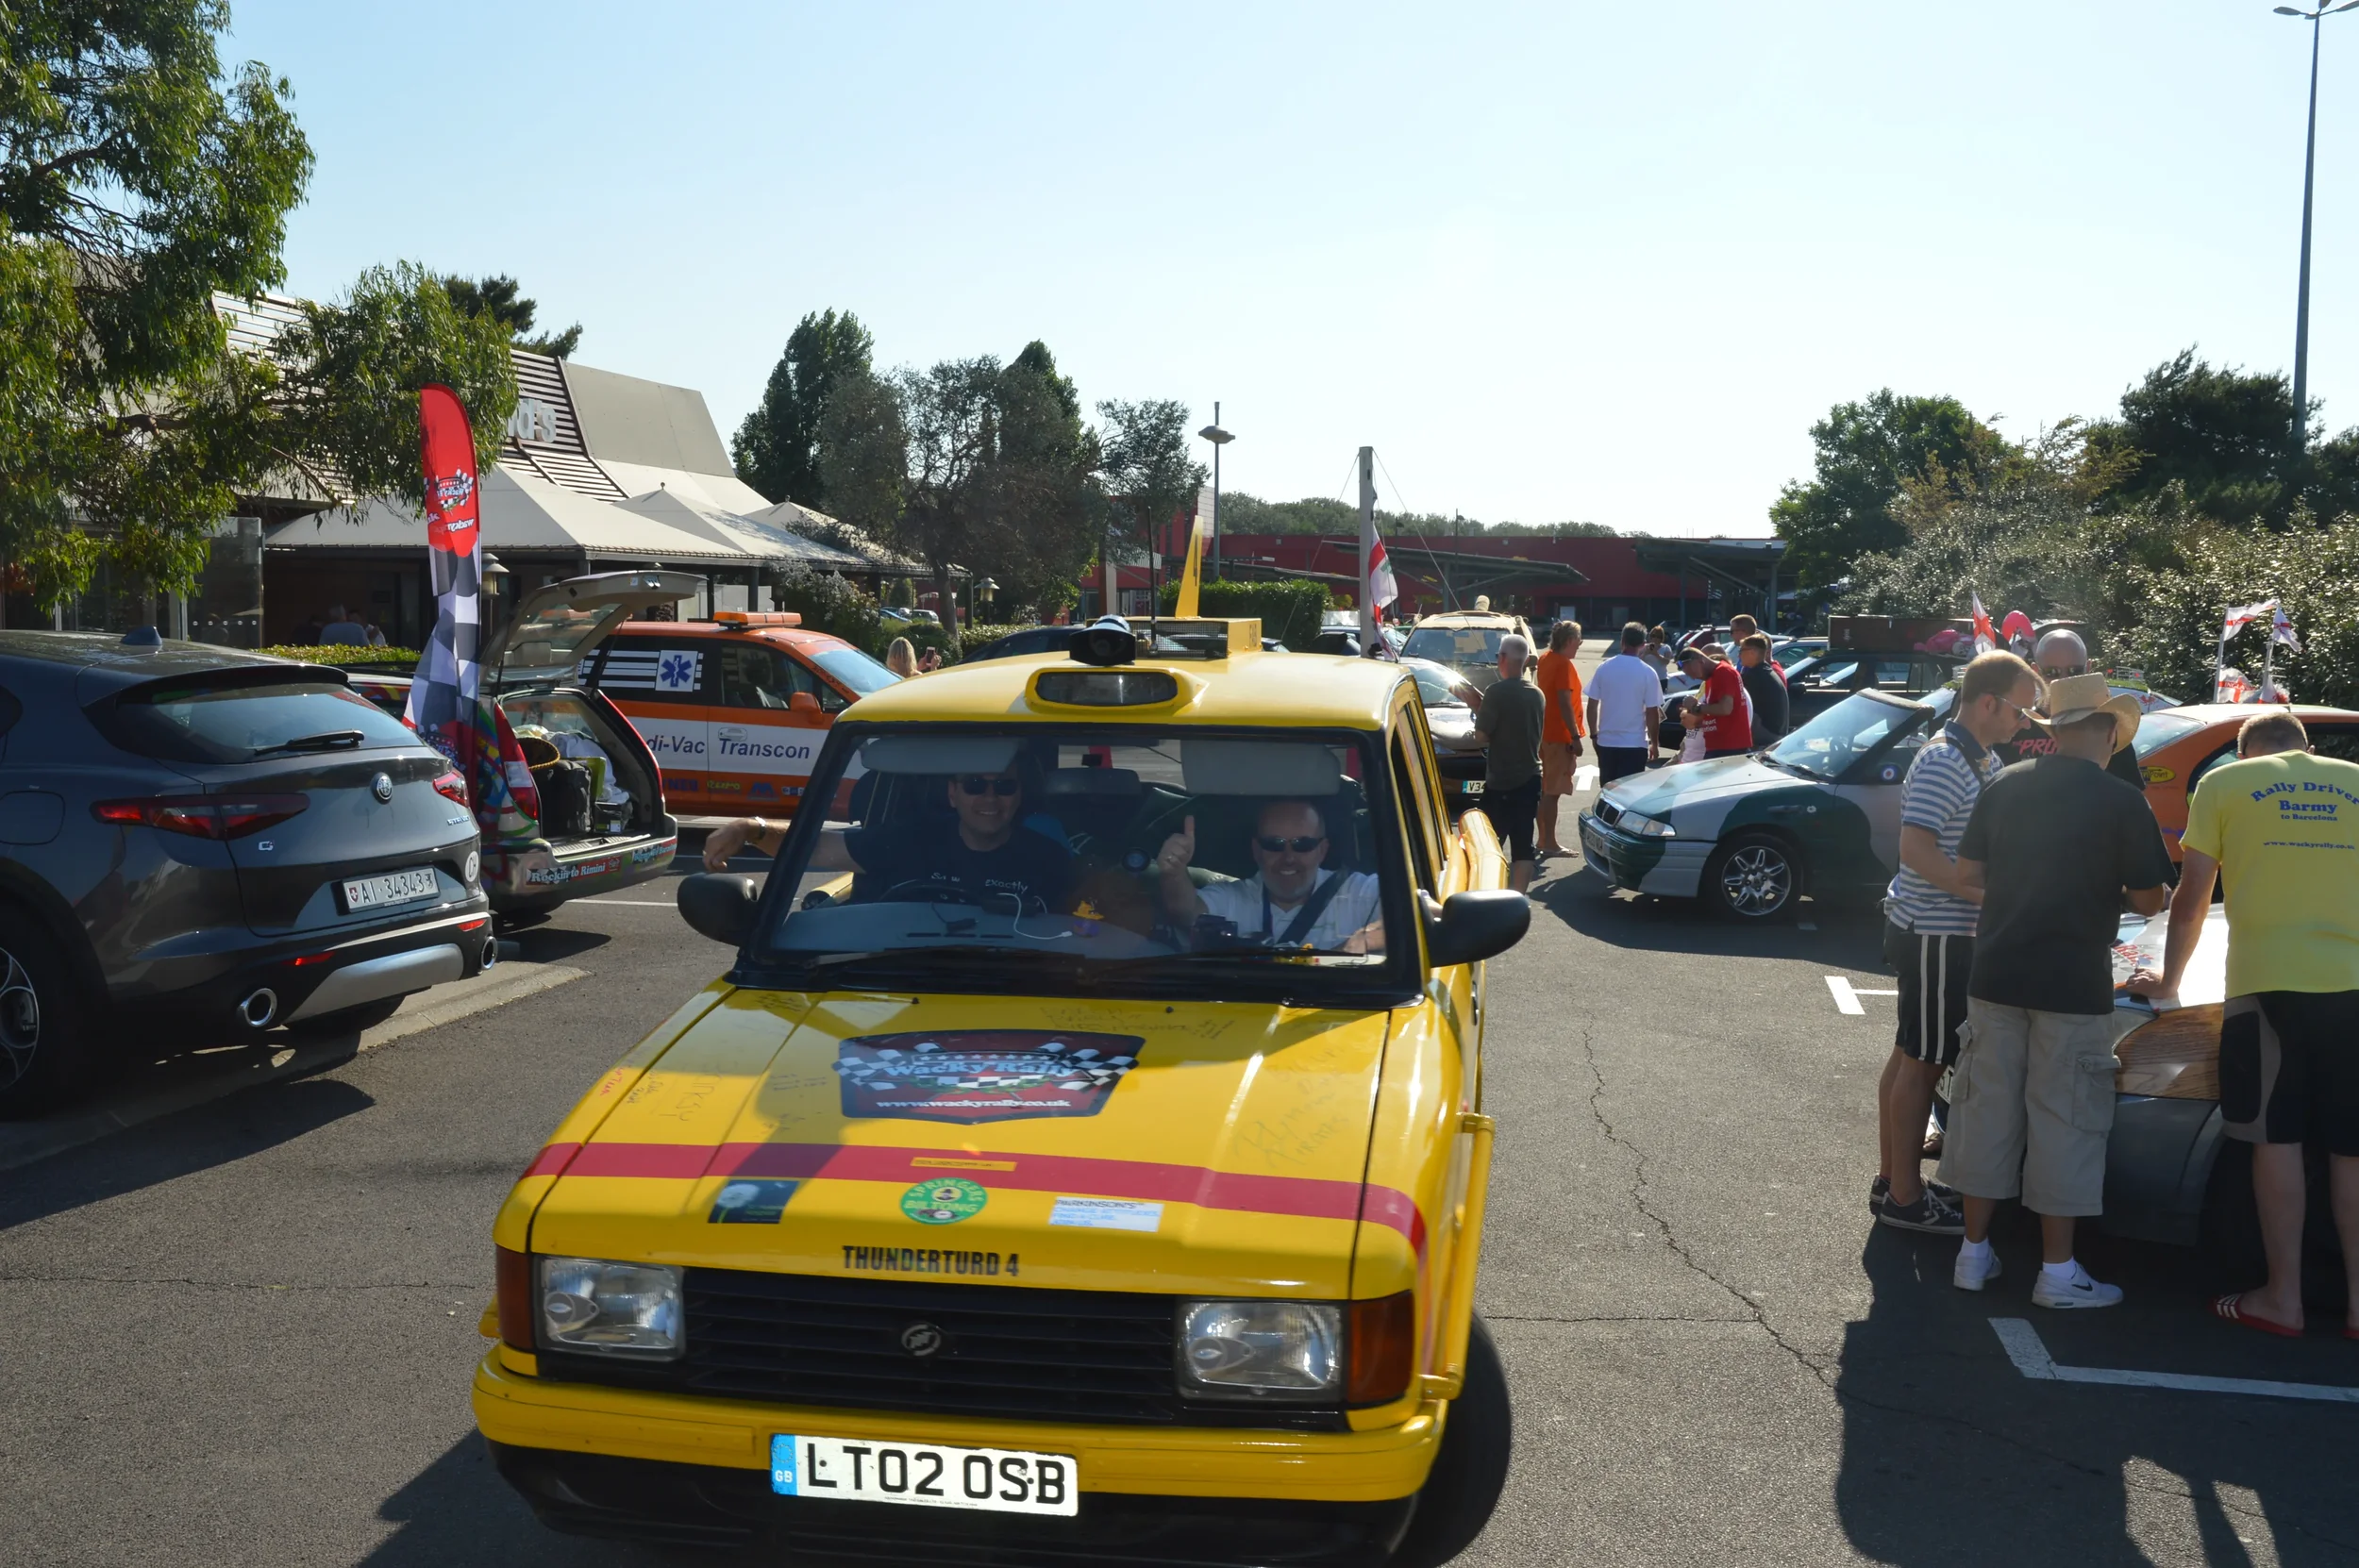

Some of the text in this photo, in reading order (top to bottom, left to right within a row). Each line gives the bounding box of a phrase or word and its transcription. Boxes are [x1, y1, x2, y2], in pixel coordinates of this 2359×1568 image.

[718, 738, 811, 759] Transcon
[2250, 781, 2297, 802] Rally
[2278, 799, 2338, 814] Barmy
[2292, 813, 2338, 822] Barcelona
[580, 862, 606, 876] Rimini
[383, 873, 425, 899] 34343
[883, 1060, 1078, 1077] Wacky Rally
[877, 1098, 1072, 1109] www.wackyrally.co.uk
[842, 1244, 1020, 1276] THUNDERTURD 4
[775, 1469, 794, 1483] GB
